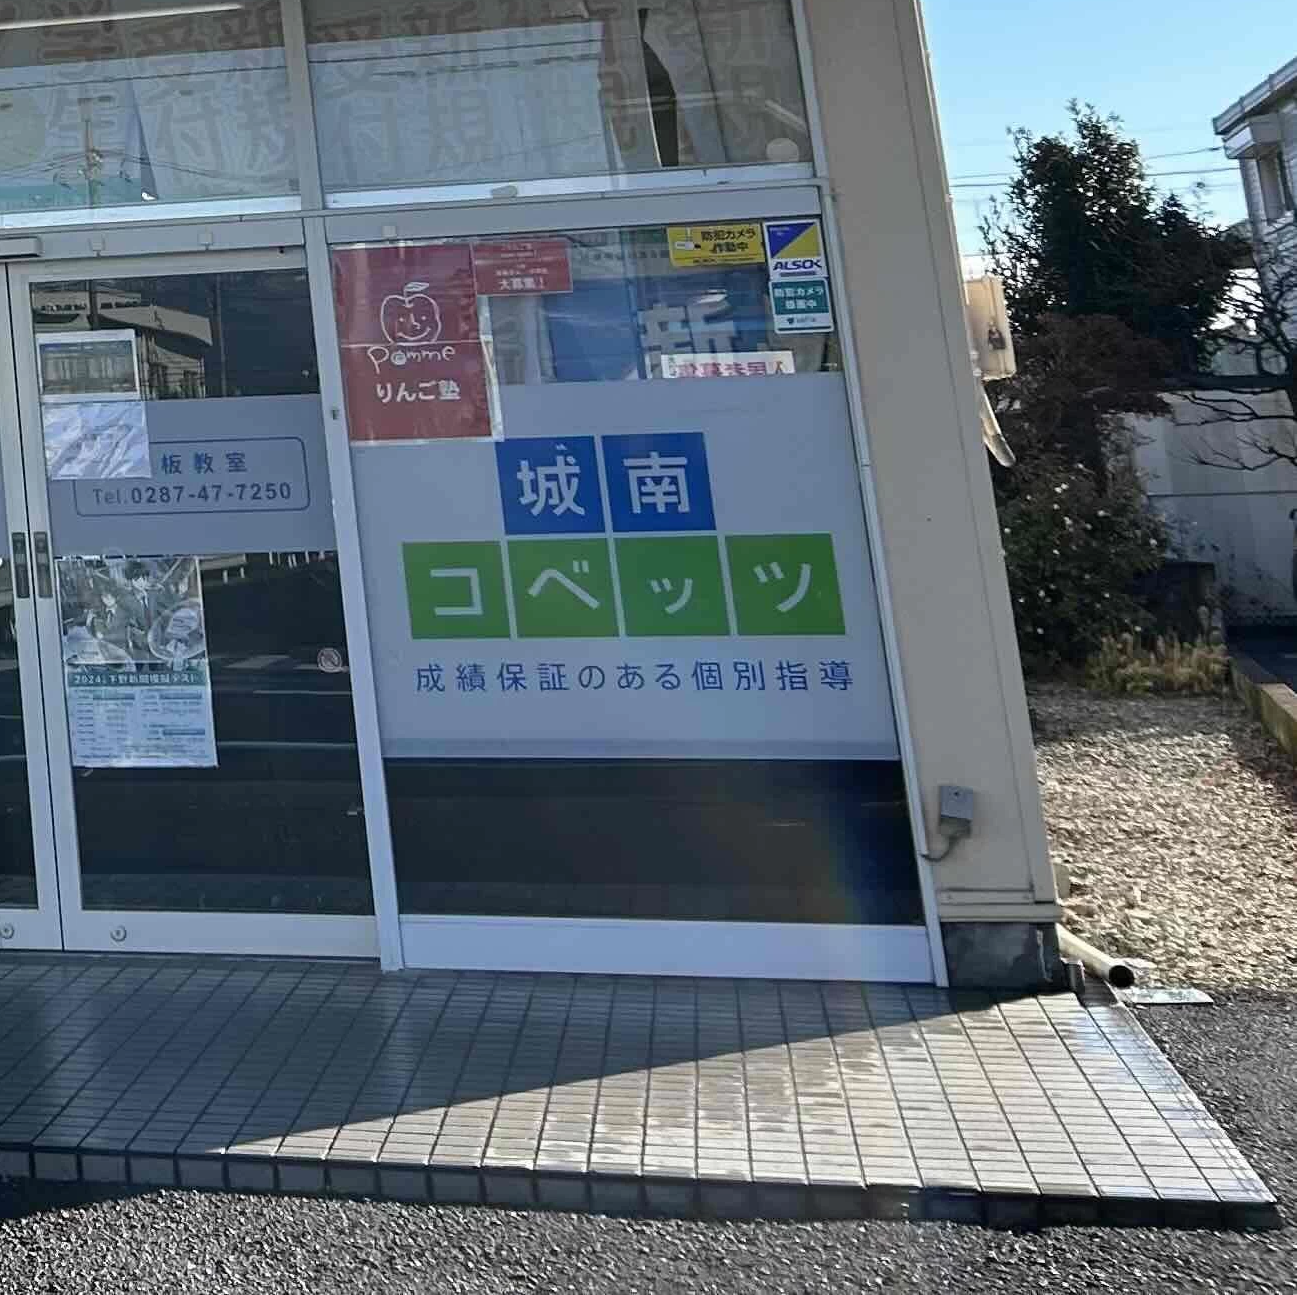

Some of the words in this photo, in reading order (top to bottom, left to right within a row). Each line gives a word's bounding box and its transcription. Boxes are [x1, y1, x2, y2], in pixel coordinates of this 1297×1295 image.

[773, 259, 823, 271] ALSOK
[516, 451, 689, 518] 城南
[430, 560, 813, 617] コベッツ
[415, 661, 854, 694] 成績保証のある個別指導
